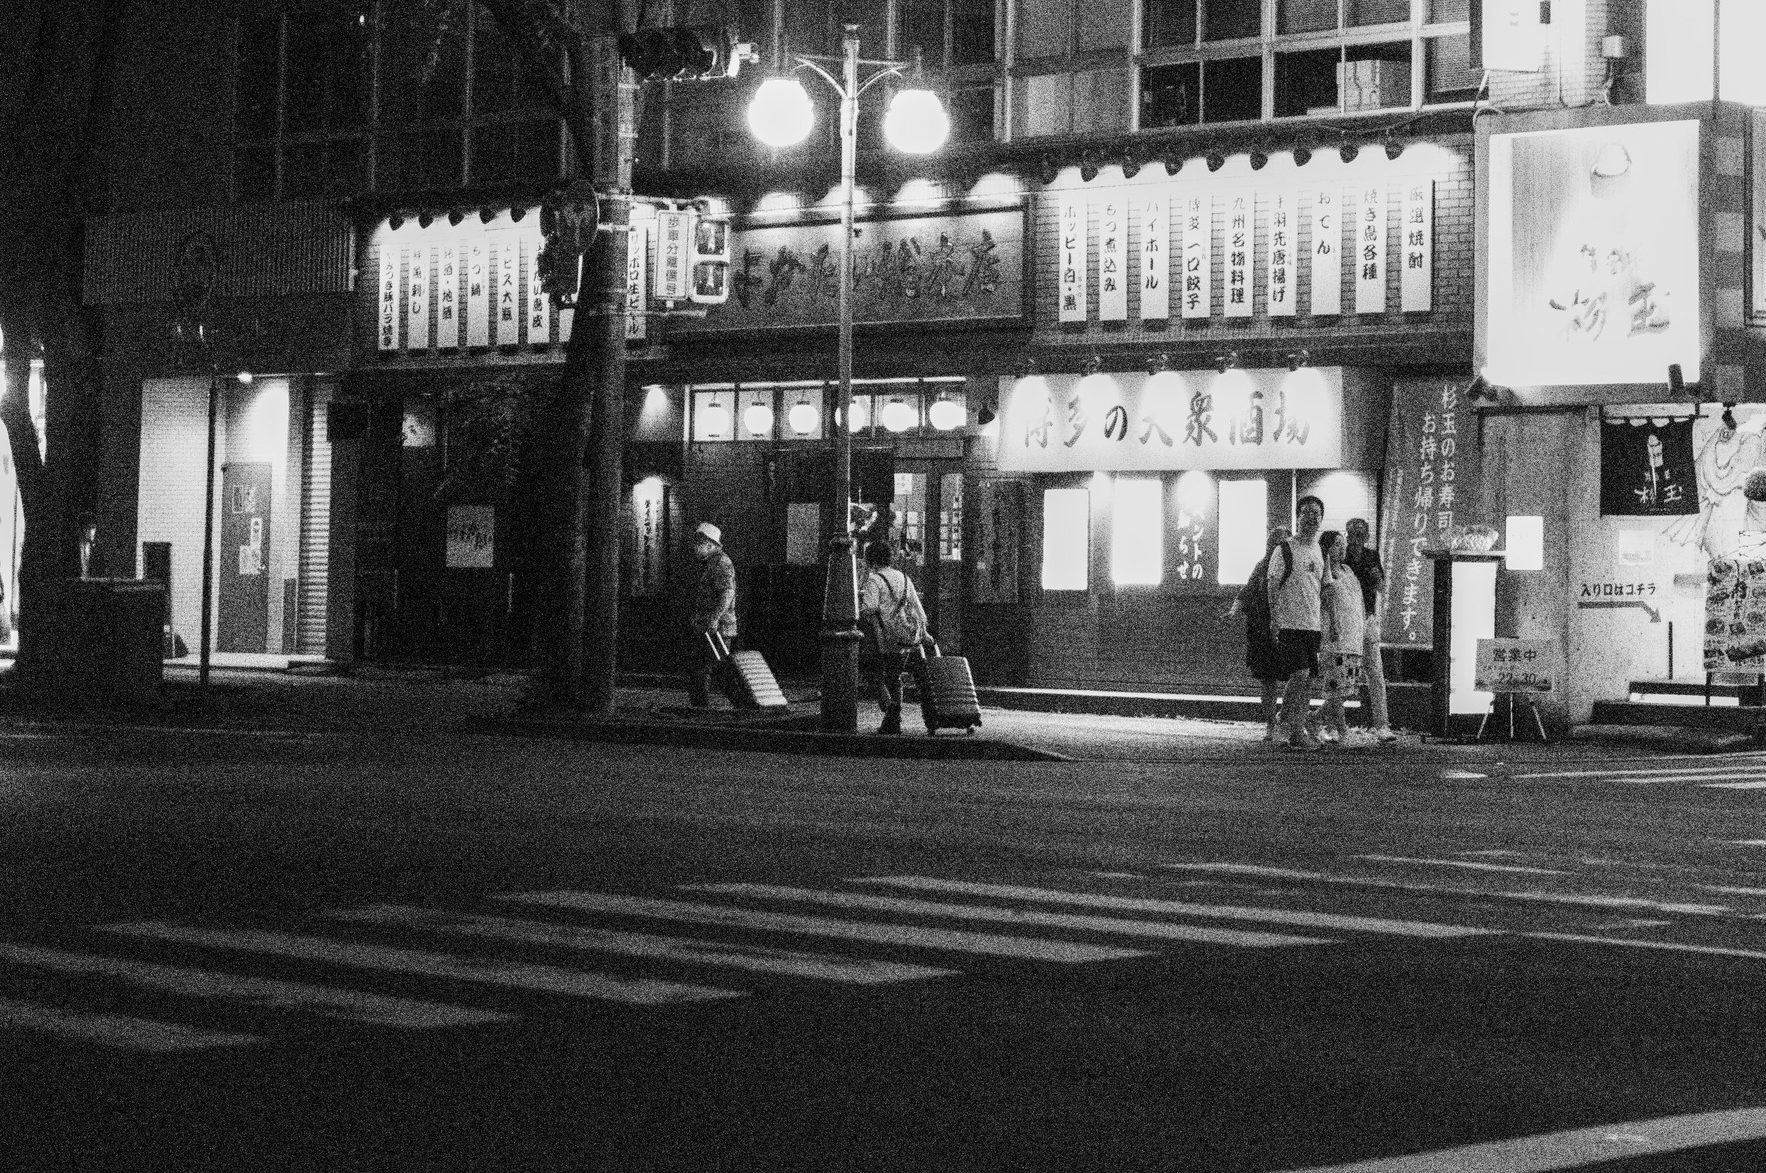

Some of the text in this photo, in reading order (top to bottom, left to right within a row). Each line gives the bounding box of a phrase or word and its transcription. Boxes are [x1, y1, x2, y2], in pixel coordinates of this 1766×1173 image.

[664, 216, 680, 296] 歩車分離信号
[1062, 204, 1078, 312] ホッピー白・黒
[1103, 203, 1118, 293] もつ煮込み
[1144, 201, 1159, 290] ハイボール
[1185, 196, 1201, 311] 博多一口餃子
[1230, 196, 1246, 305] 九州名物料理
[1271, 194, 1287, 303] 手羽先唐揚げ
[1316, 190, 1332, 256] おでん
[1361, 188, 1378, 280] 焼き鳥各種
[1408, 185, 1425, 270] 厳選焼酎
[470, 245, 482, 298] もつ鍋
[501, 242, 513, 322] エビス大瓶
[627, 228, 641, 336] サッポロ生ビール
[1024, 389, 1311, 449] 博多の大衆酒場
[1438, 384, 1457, 530] 杉玉のお寿司
[1400, 411, 1437, 642] お持ち帰りできます。
[1633, 483, 1683, 505] 杉玉
[1580, 583, 1657, 597] 入り口はコチラ
[1492, 647, 1537, 662] 営業中
